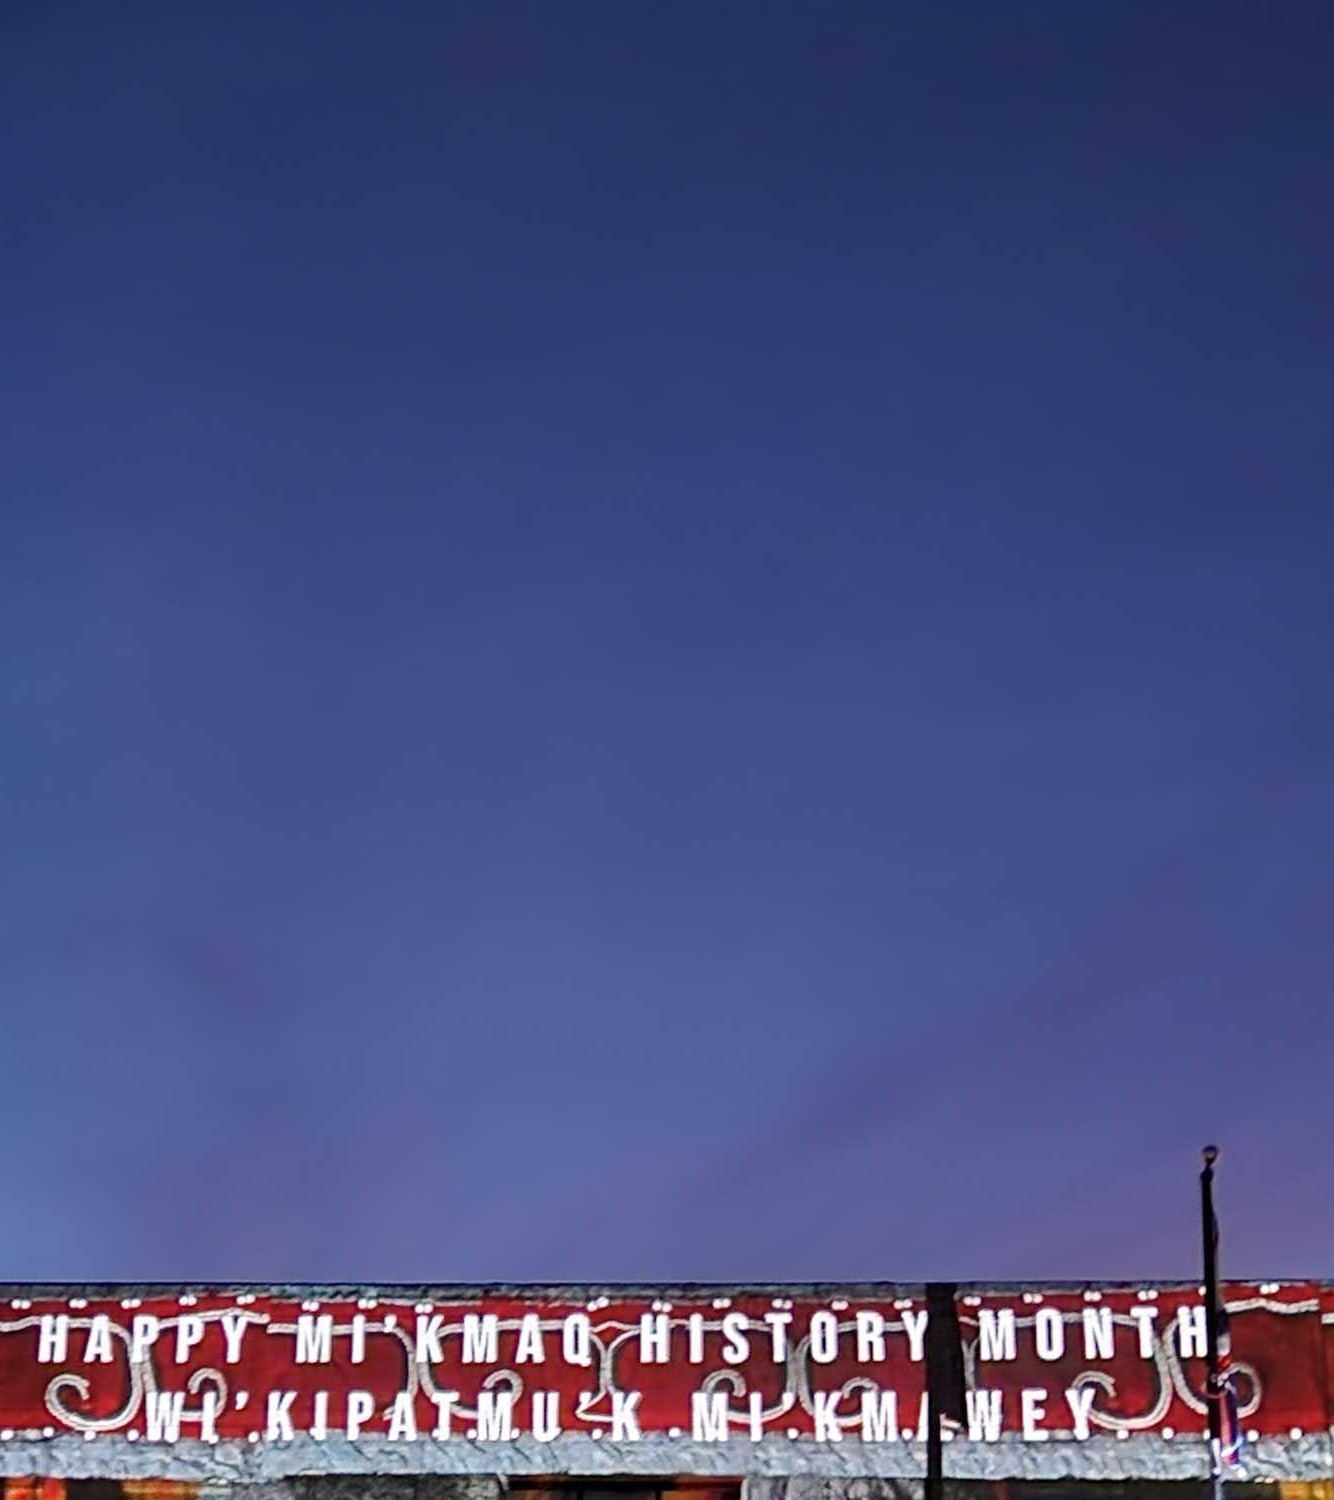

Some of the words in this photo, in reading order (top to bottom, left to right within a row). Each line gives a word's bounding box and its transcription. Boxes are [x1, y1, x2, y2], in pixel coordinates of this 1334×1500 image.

[38, 1313, 248, 1363] HAPPY
[639, 1308, 929, 1364] HISTORY
[978, 1304, 1209, 1361] MONTH
